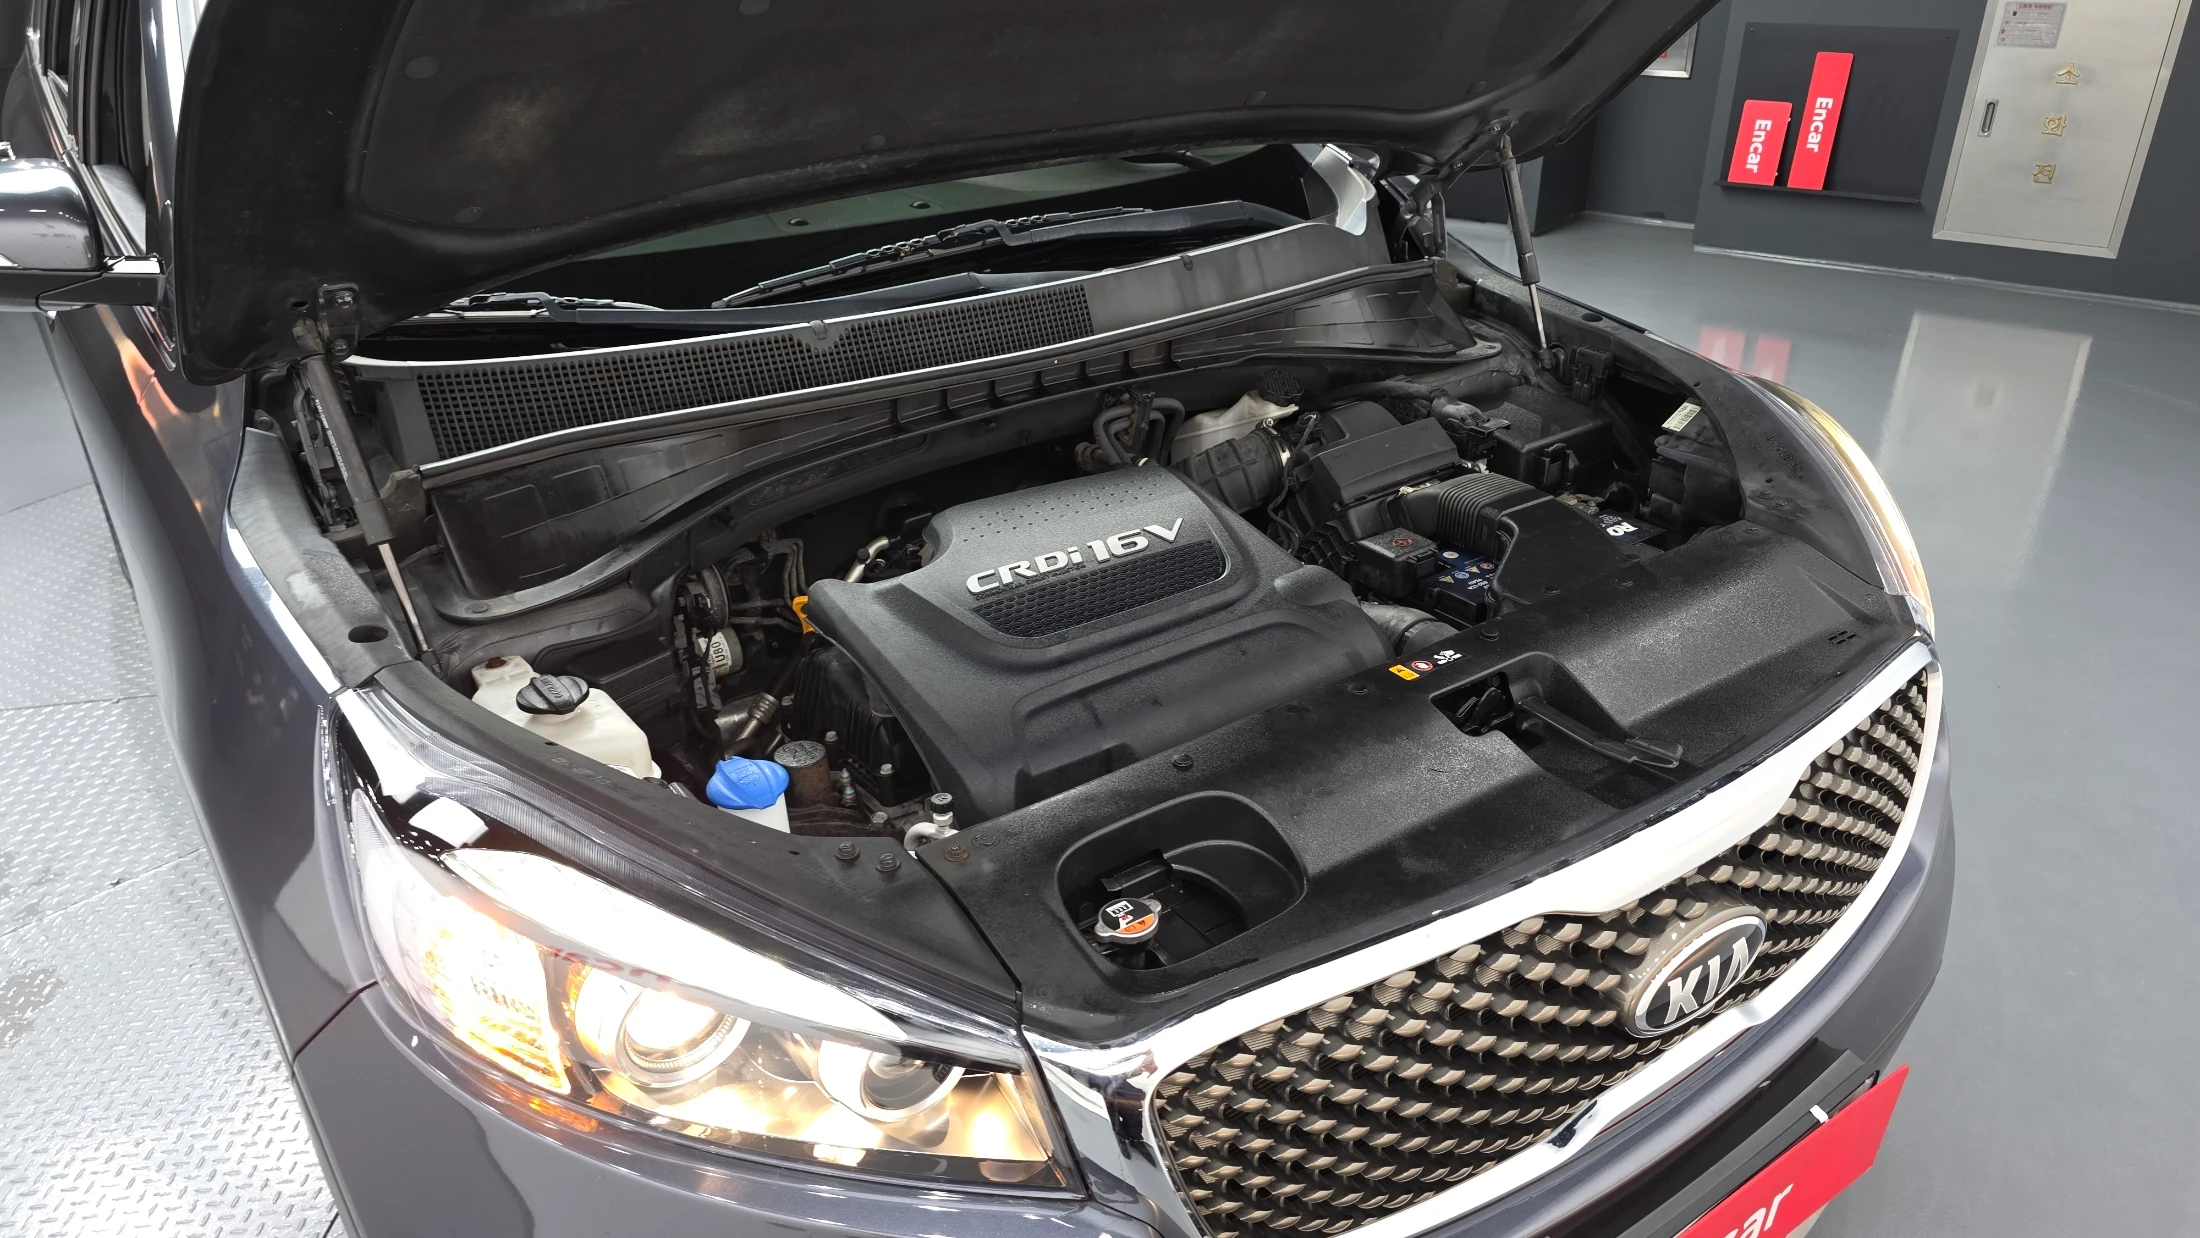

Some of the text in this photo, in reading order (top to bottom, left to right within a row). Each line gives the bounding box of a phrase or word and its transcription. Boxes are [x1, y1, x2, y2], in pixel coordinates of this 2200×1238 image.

[1745, 118, 1773, 174] Encar
[1805, 96, 1834, 153] Encar
[2032, 62, 2081, 185] 소화전
[966, 517, 1185, 596] CRDi 16V
[710, 641, 726, 663] U80
[1663, 936, 1751, 1025] KIA
[1723, 1182, 1794, 1238] ar
